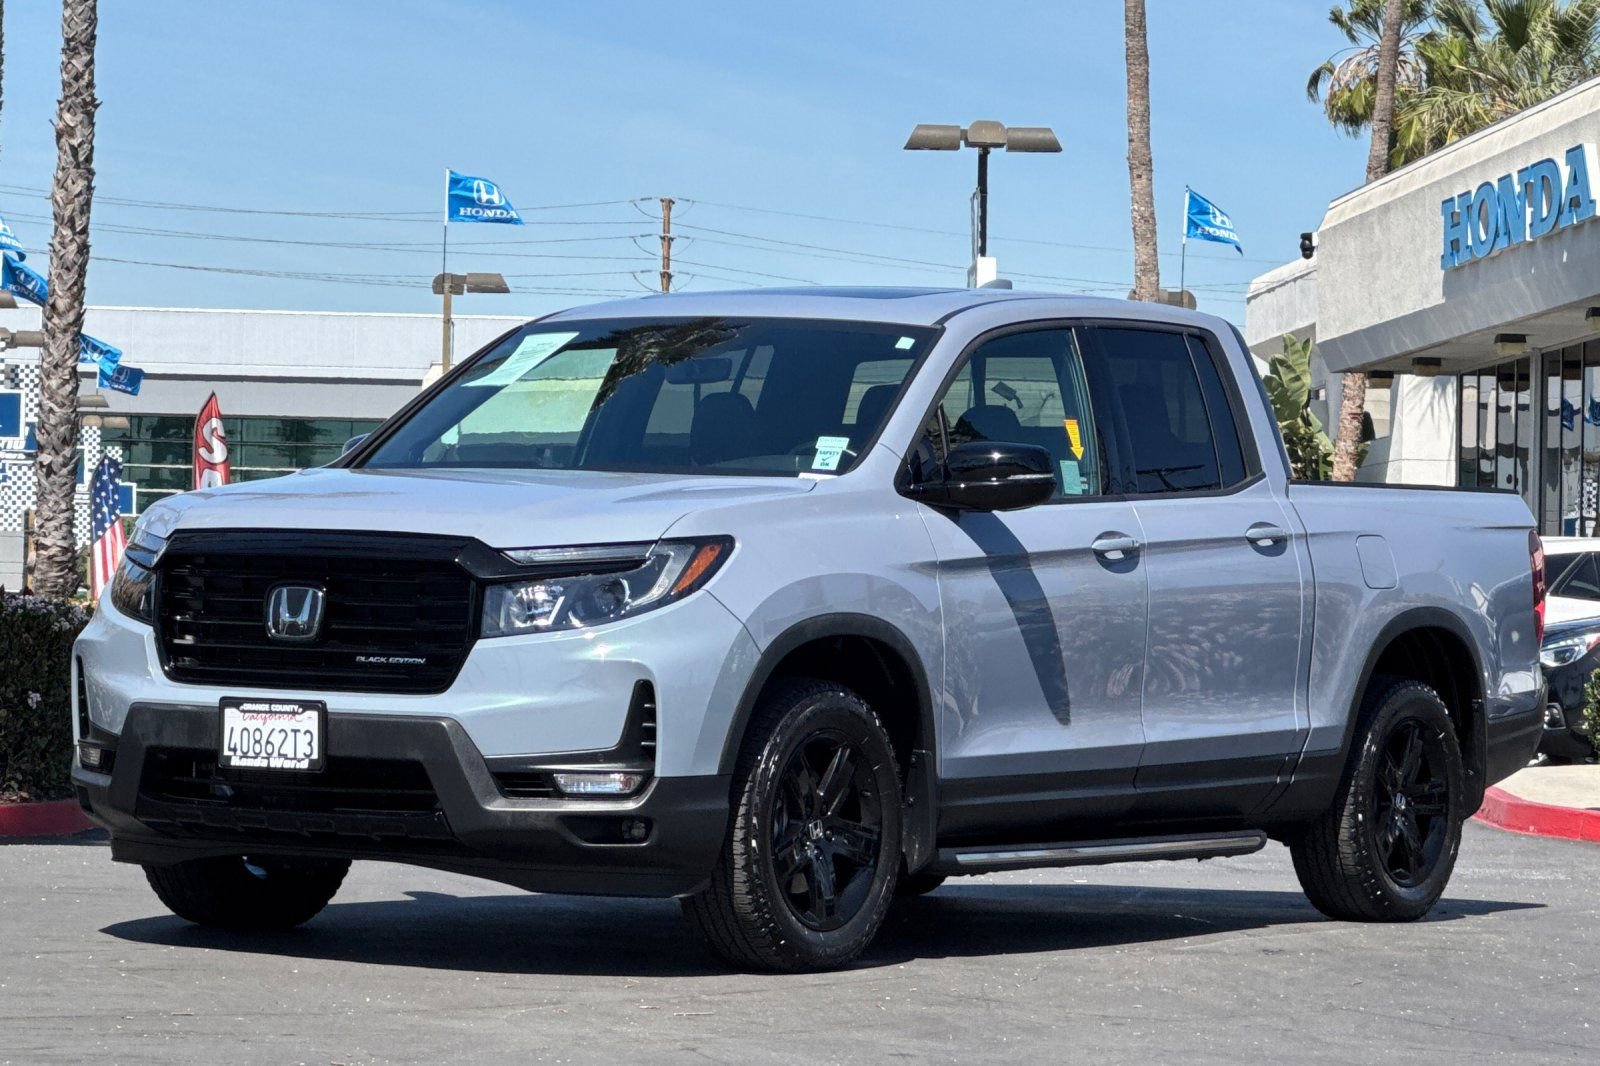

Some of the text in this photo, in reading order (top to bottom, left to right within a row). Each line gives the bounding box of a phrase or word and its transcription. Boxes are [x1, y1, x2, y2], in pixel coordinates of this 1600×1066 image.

[459, 207, 519, 218] HONDA
[1441, 144, 1597, 270] HONDA
[243, 703, 298, 712] ORANGE COUNTY
[228, 726, 314, 759] 40862T3
[230, 756, 309, 769] Honda World
